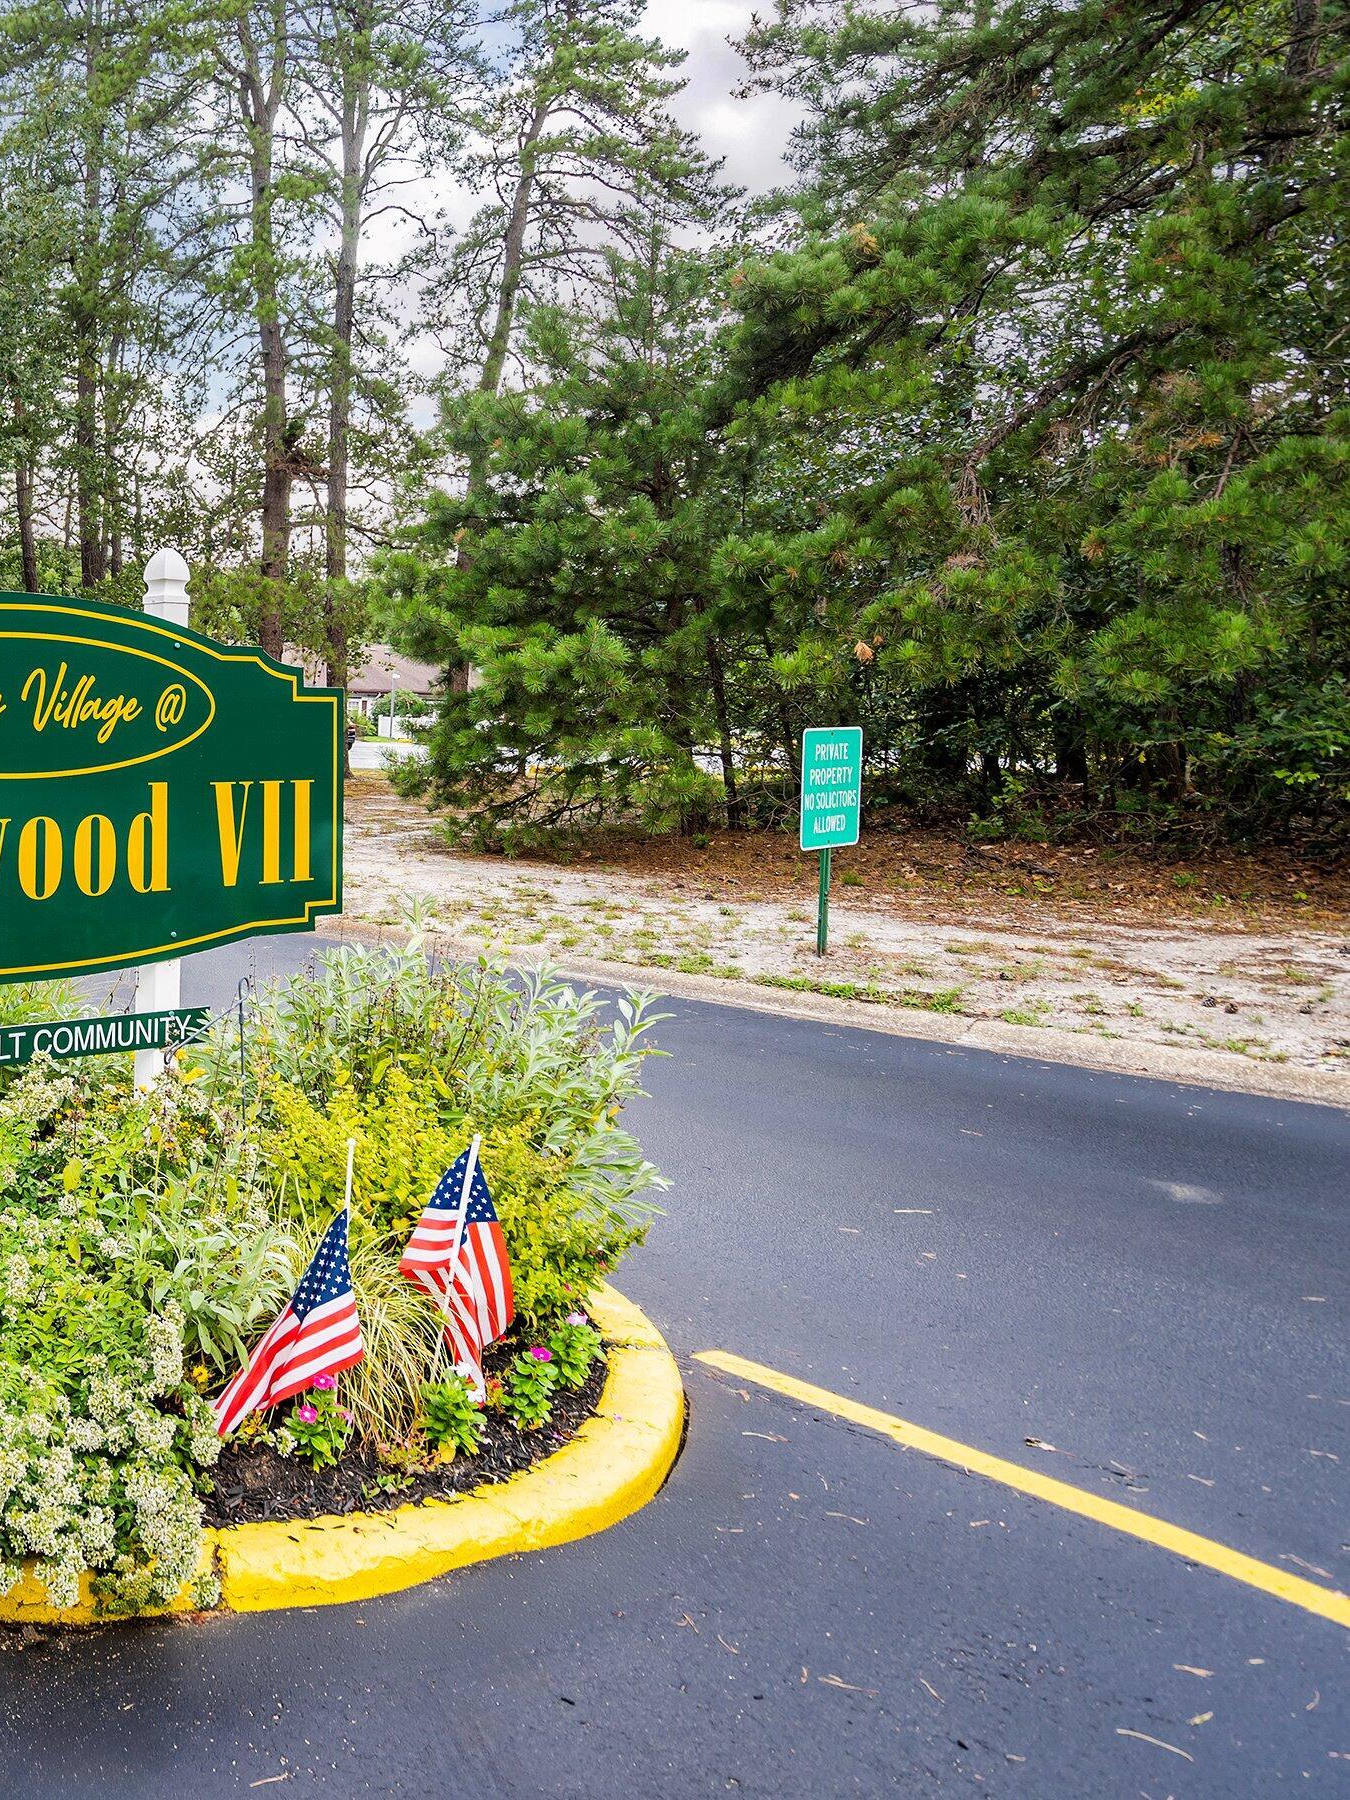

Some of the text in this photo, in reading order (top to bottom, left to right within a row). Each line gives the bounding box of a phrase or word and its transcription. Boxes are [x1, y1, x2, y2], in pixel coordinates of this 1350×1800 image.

[21, 662, 143, 744] Village
[155, 683, 187, 732] @
[815, 743, 849, 761] PRIVATE
[809, 766, 853, 786] PROPERTY
[804, 789, 857, 811] NO SOLICITORS
[210, 779, 316, 887] VII
[813, 815, 845, 834] ALLOWED
[33, 1014, 192, 1054] COMMUNITY
